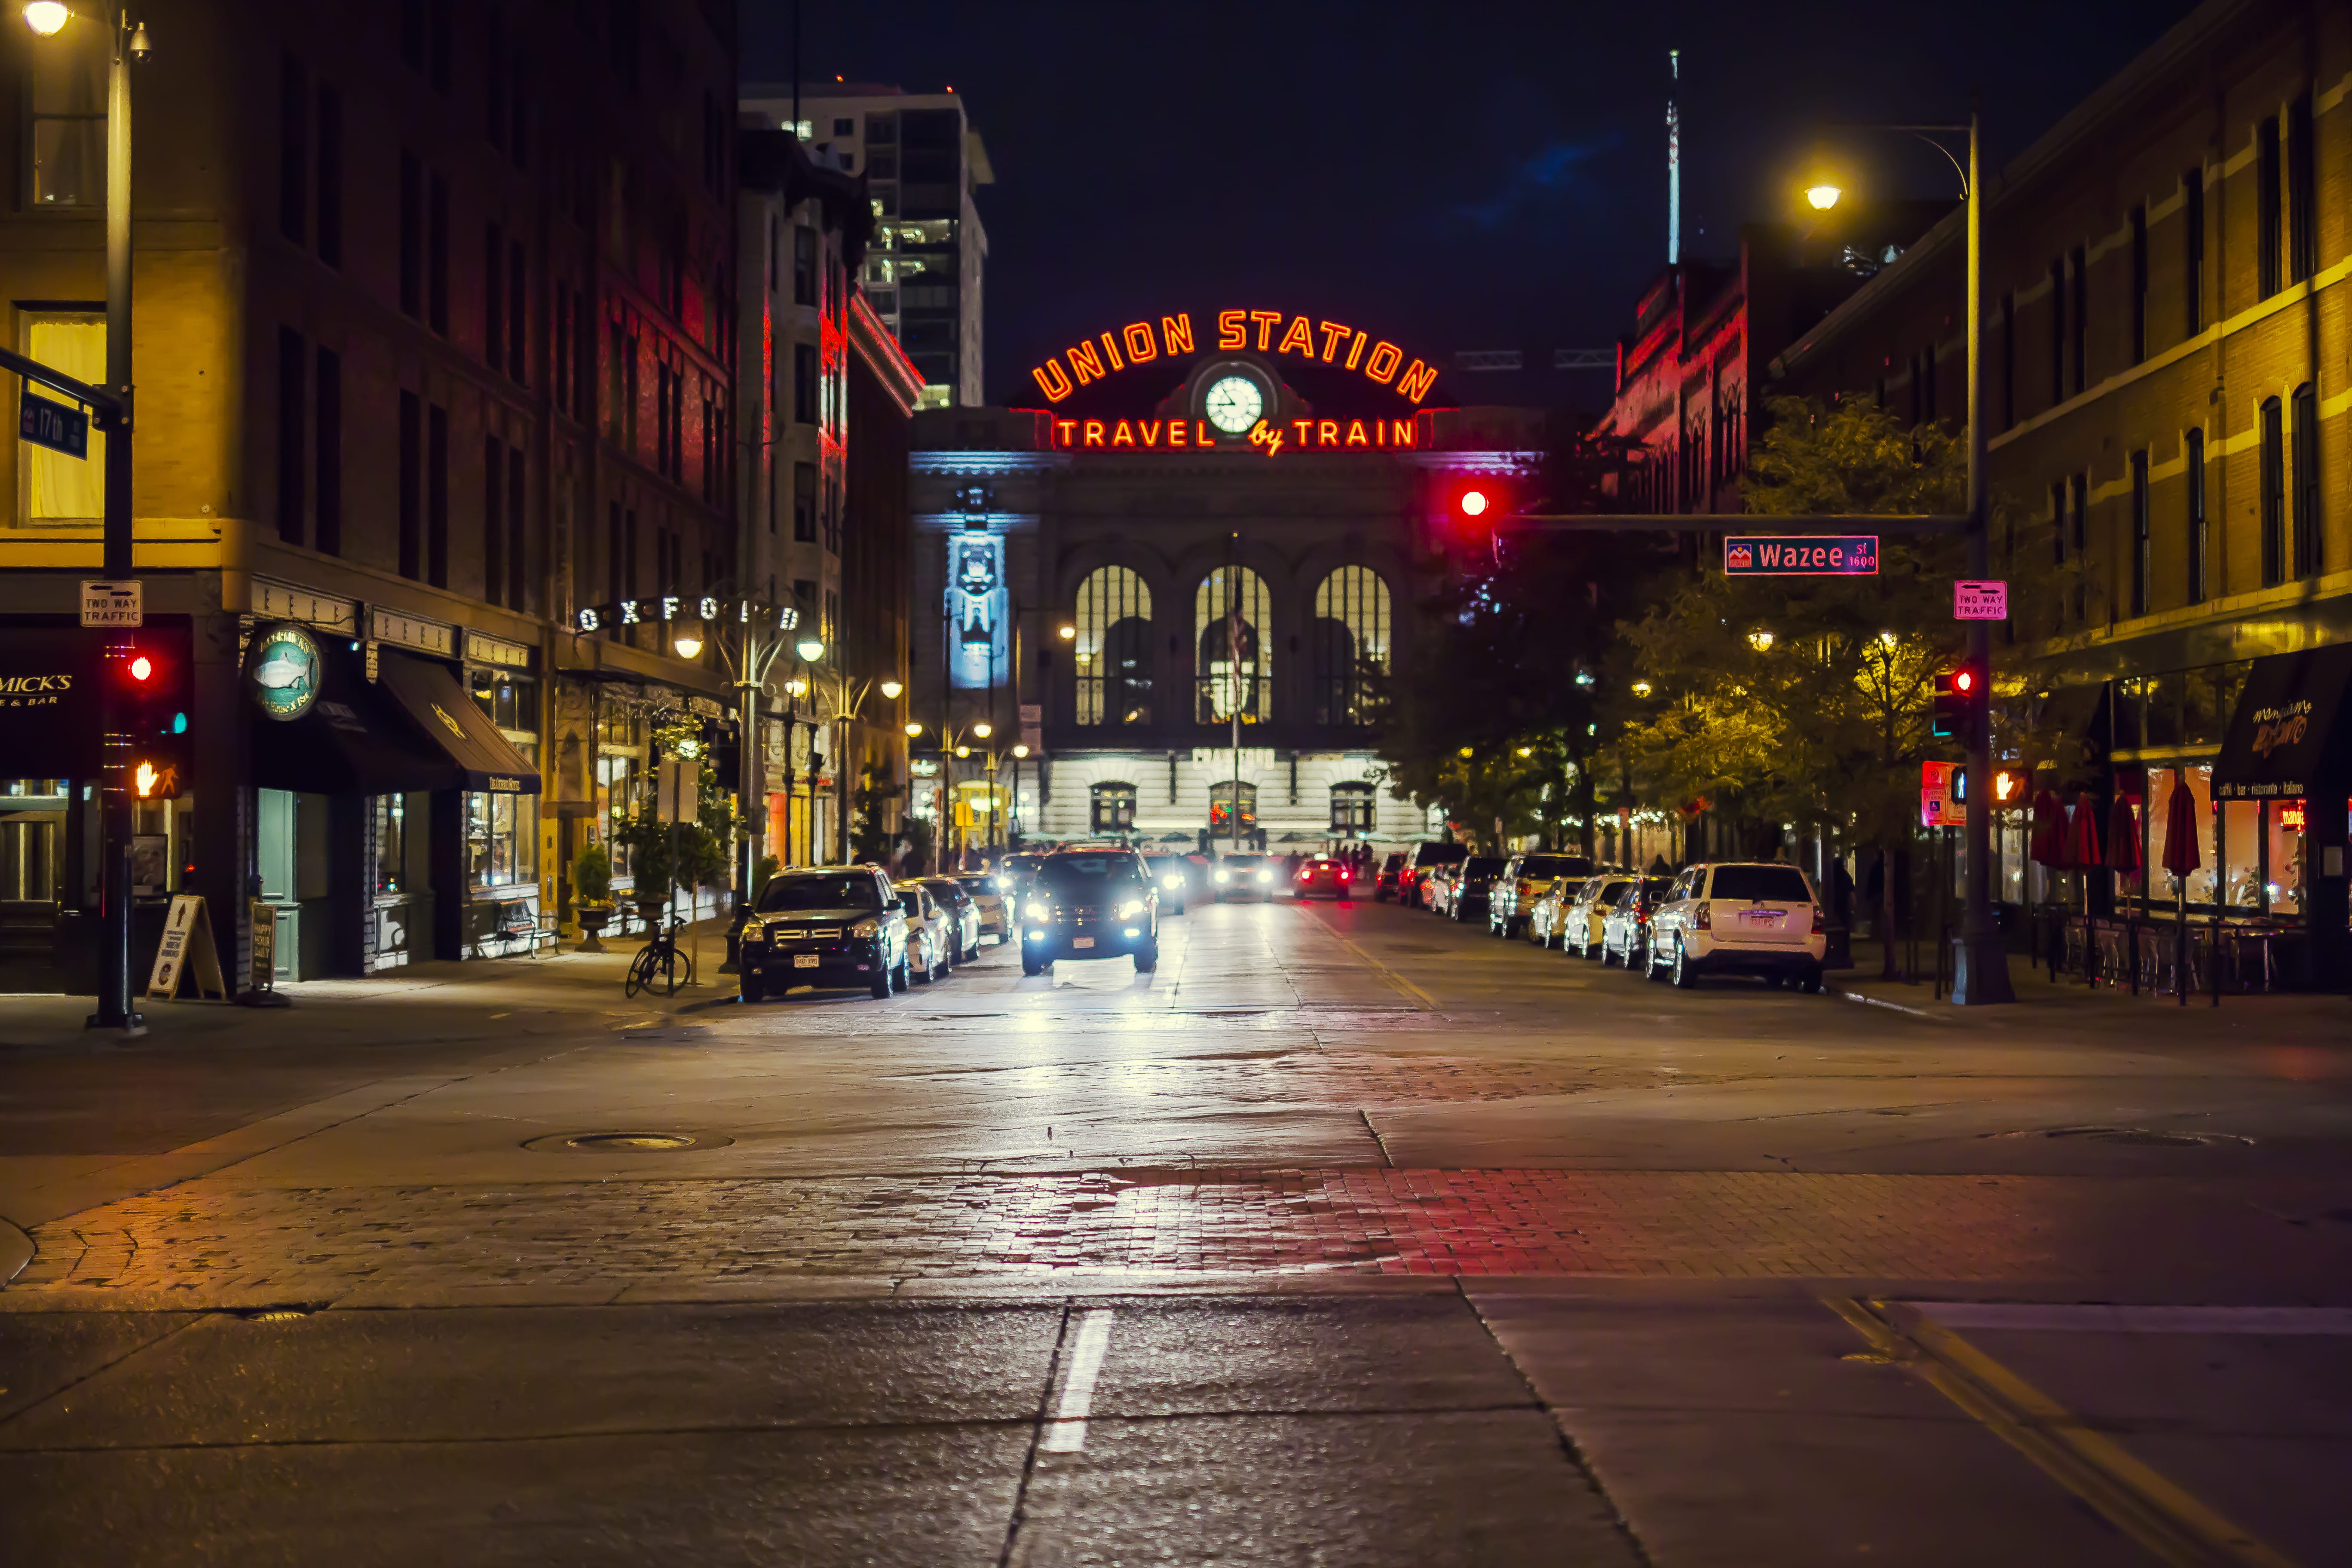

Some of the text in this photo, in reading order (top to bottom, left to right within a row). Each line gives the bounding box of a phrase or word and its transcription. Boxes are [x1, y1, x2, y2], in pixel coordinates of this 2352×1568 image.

[1032, 309, 1438, 404] UNION STATION
[1057, 419, 1412, 457] TRAVEL by TRAIN
[1759, 544, 1843, 567] Wazee
[1849, 556, 1874, 568] 1600
[86, 598, 137, 608] TWO WAY
[1960, 596, 2002, 604] TWO WAY
[85, 611, 138, 621] TRAFFIC
[1958, 606, 2003, 615] TRAFFIC
[28, 697, 57, 706] BAR
[2237, 783, 2245, 795] bar
[2252, 782, 2277, 795] ristorante
[2283, 781, 2303, 794] italiano
